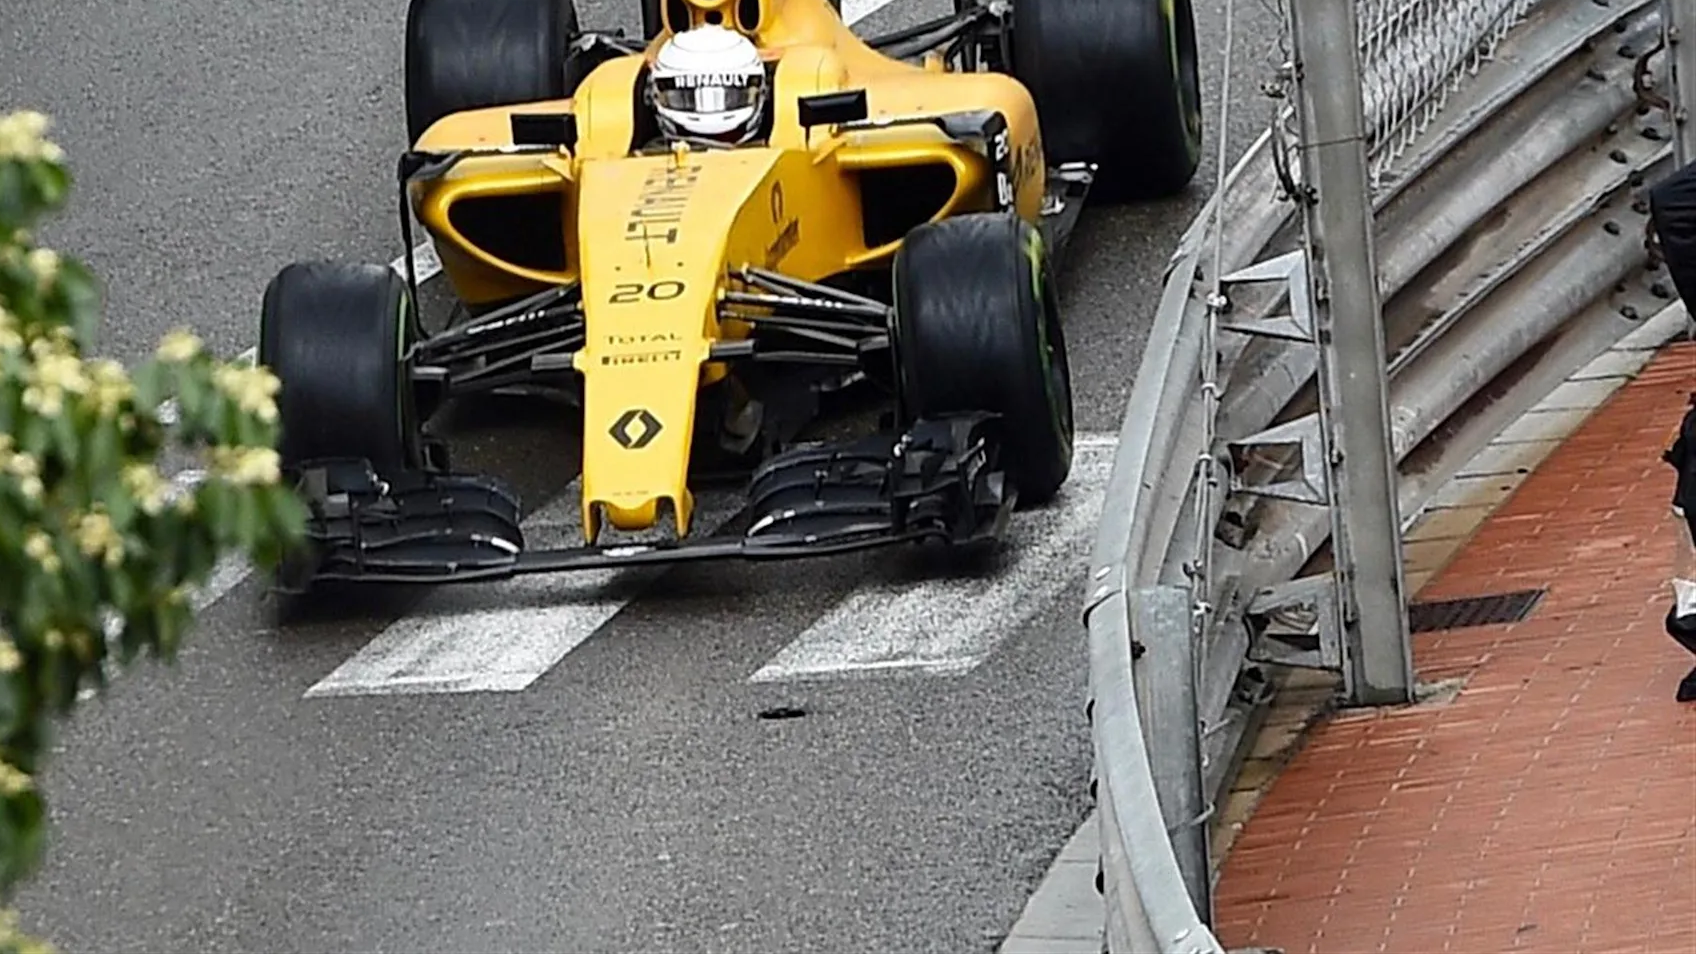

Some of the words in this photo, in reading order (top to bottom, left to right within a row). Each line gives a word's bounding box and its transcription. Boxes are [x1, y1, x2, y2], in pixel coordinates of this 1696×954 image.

[674, 72, 750, 89] RENAULT
[608, 280, 686, 305] 20
[603, 332, 683, 345] TOTAL
[601, 349, 682, 366] PIRELLI
